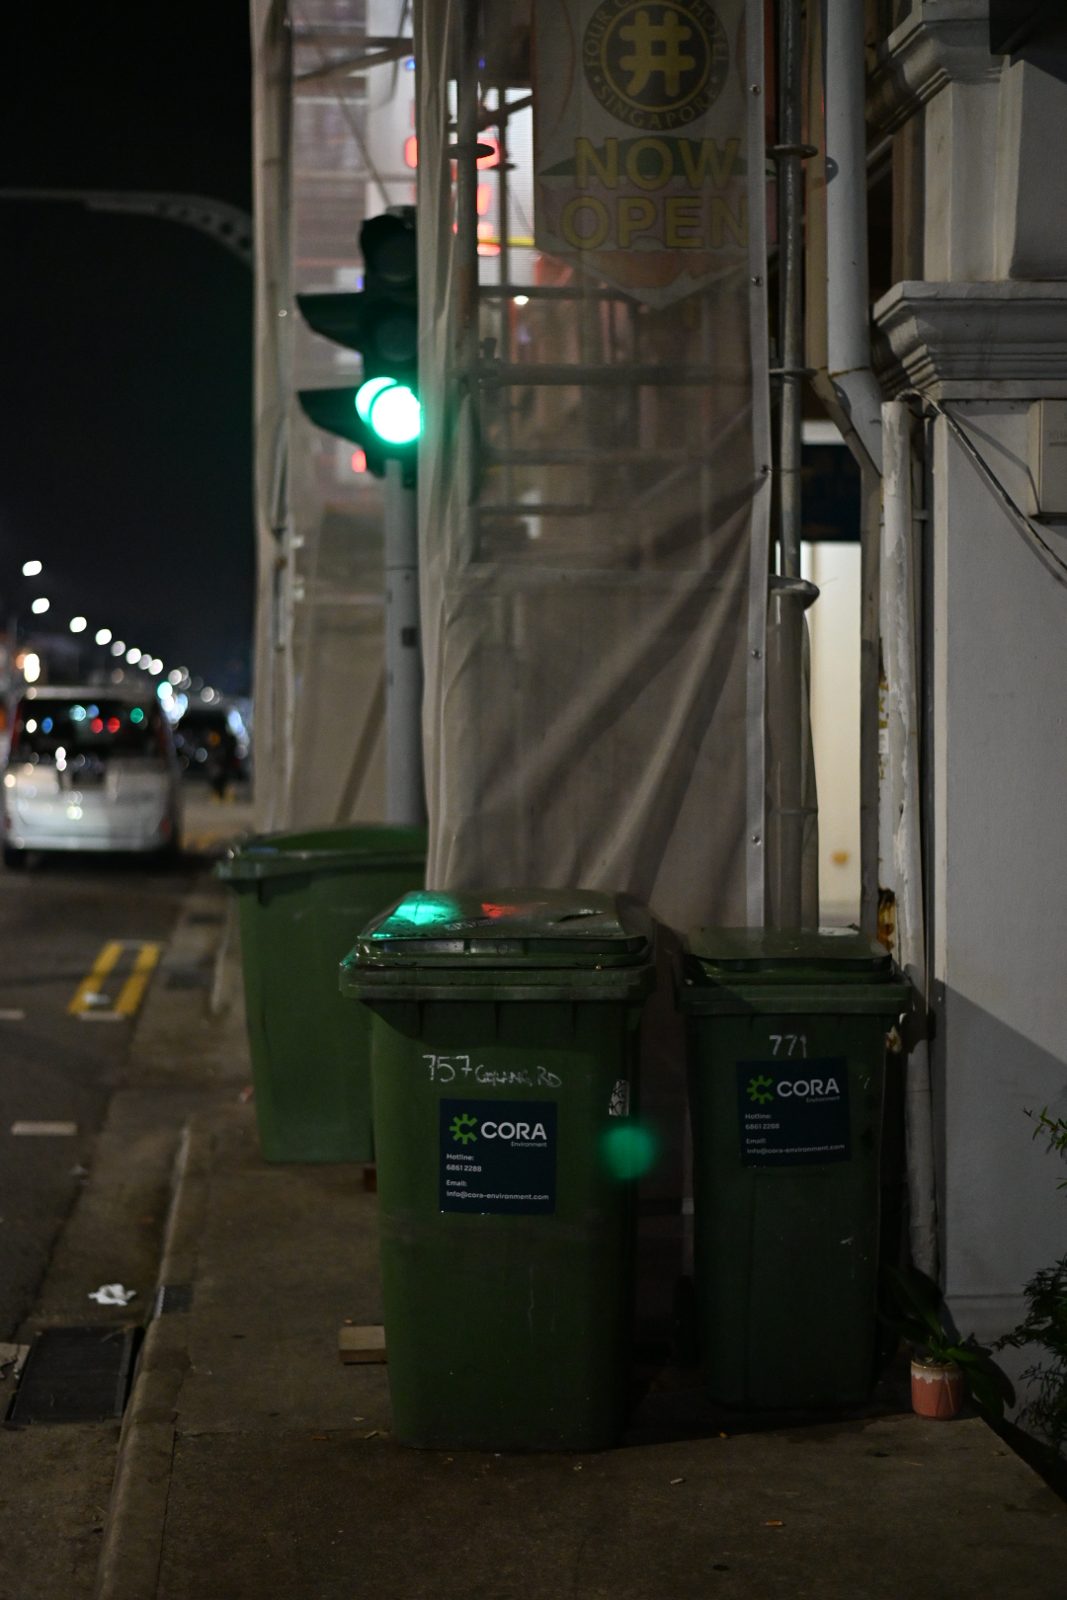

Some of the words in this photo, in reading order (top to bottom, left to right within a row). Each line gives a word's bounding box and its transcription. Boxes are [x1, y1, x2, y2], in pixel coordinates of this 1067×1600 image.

[598, 86, 719, 129] SINGAPORE
[574, 137, 742, 193] NOW
[561, 195, 748, 251] OPEN
[768, 1034, 808, 1059] 771
[421, 1054, 473, 1083] 757
[777, 1077, 840, 1097] CORA
[480, 1121, 548, 1140] CORA
[445, 1152, 475, 1162] Hotline:
[445, 1179, 468, 1187] Email:
[446, 1190, 550, 1201] info@cora-environment.com
